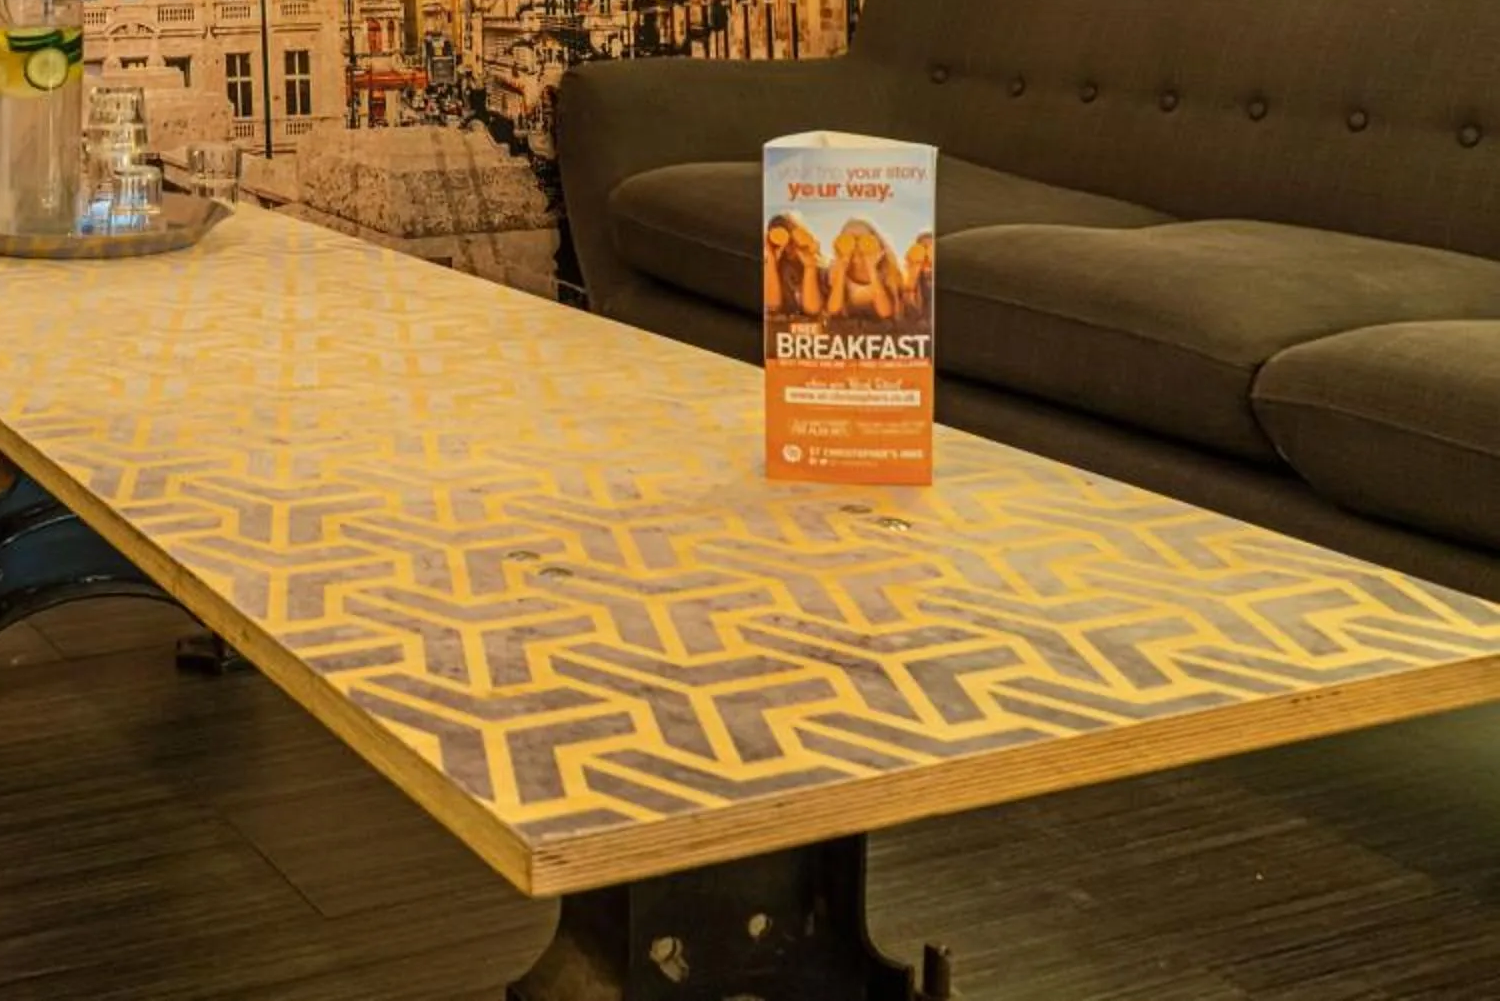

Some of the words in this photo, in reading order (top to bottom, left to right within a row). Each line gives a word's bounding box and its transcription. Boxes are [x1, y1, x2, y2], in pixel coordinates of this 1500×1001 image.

[846, 167, 881, 182] your
[787, 183, 840, 202] your
[846, 183, 894, 202] way.
[776, 332, 931, 360] BREAKFAST
